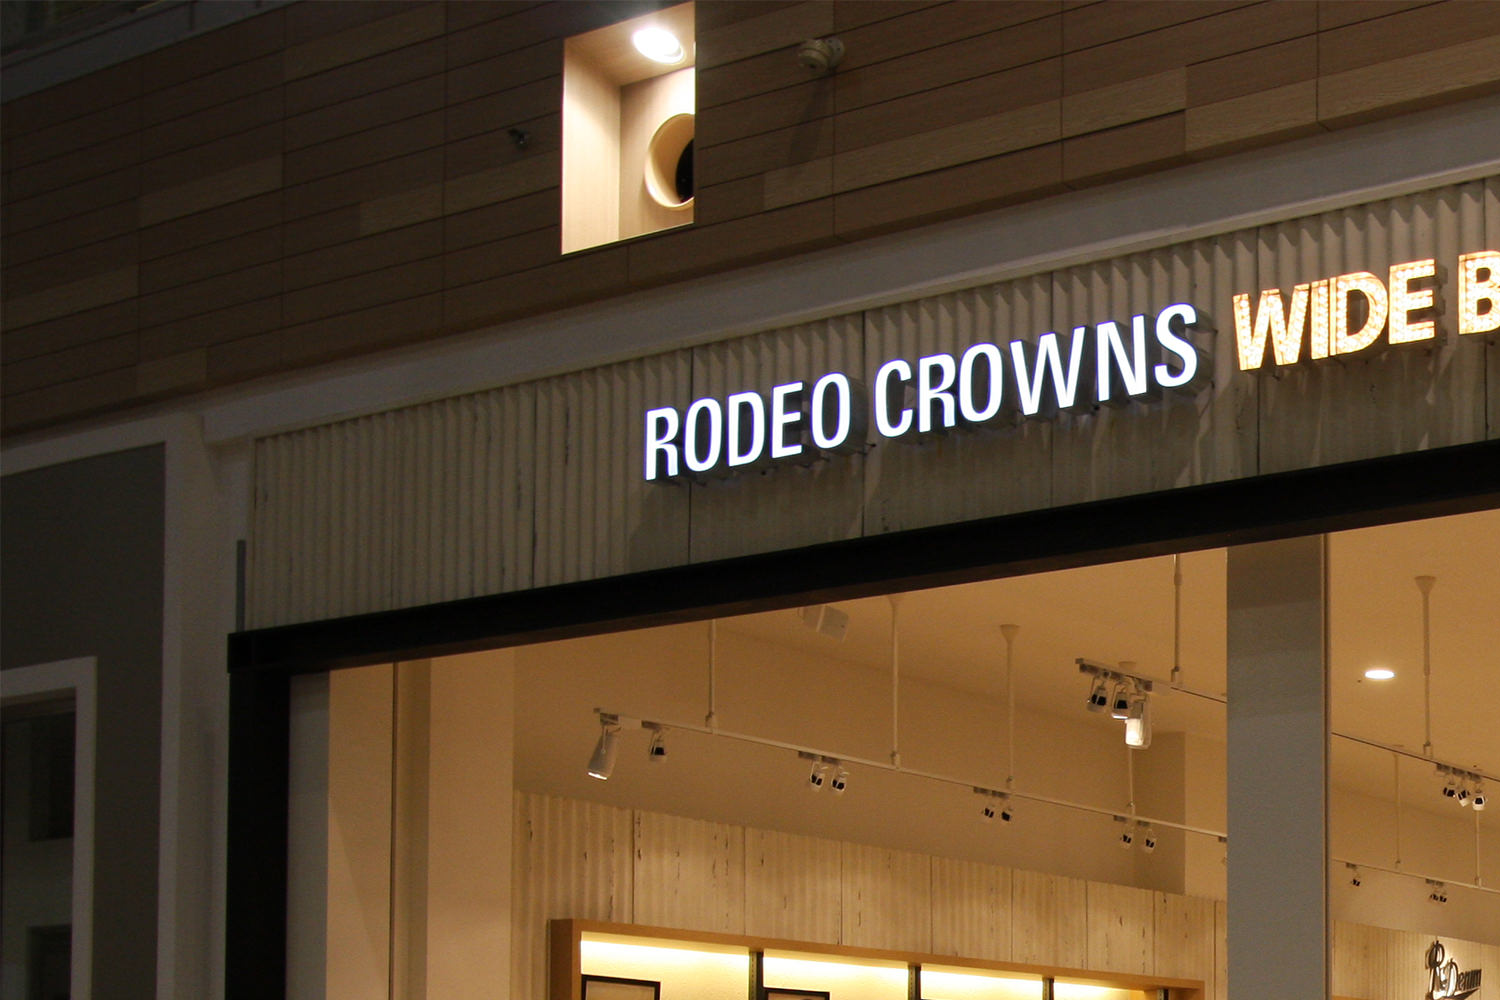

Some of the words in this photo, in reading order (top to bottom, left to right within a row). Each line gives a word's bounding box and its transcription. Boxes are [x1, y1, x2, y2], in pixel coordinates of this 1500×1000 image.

[645, 371, 851, 481] RODEO
[874, 302, 1199, 439] CROWNS
[1232, 258, 1436, 372] WIDE
